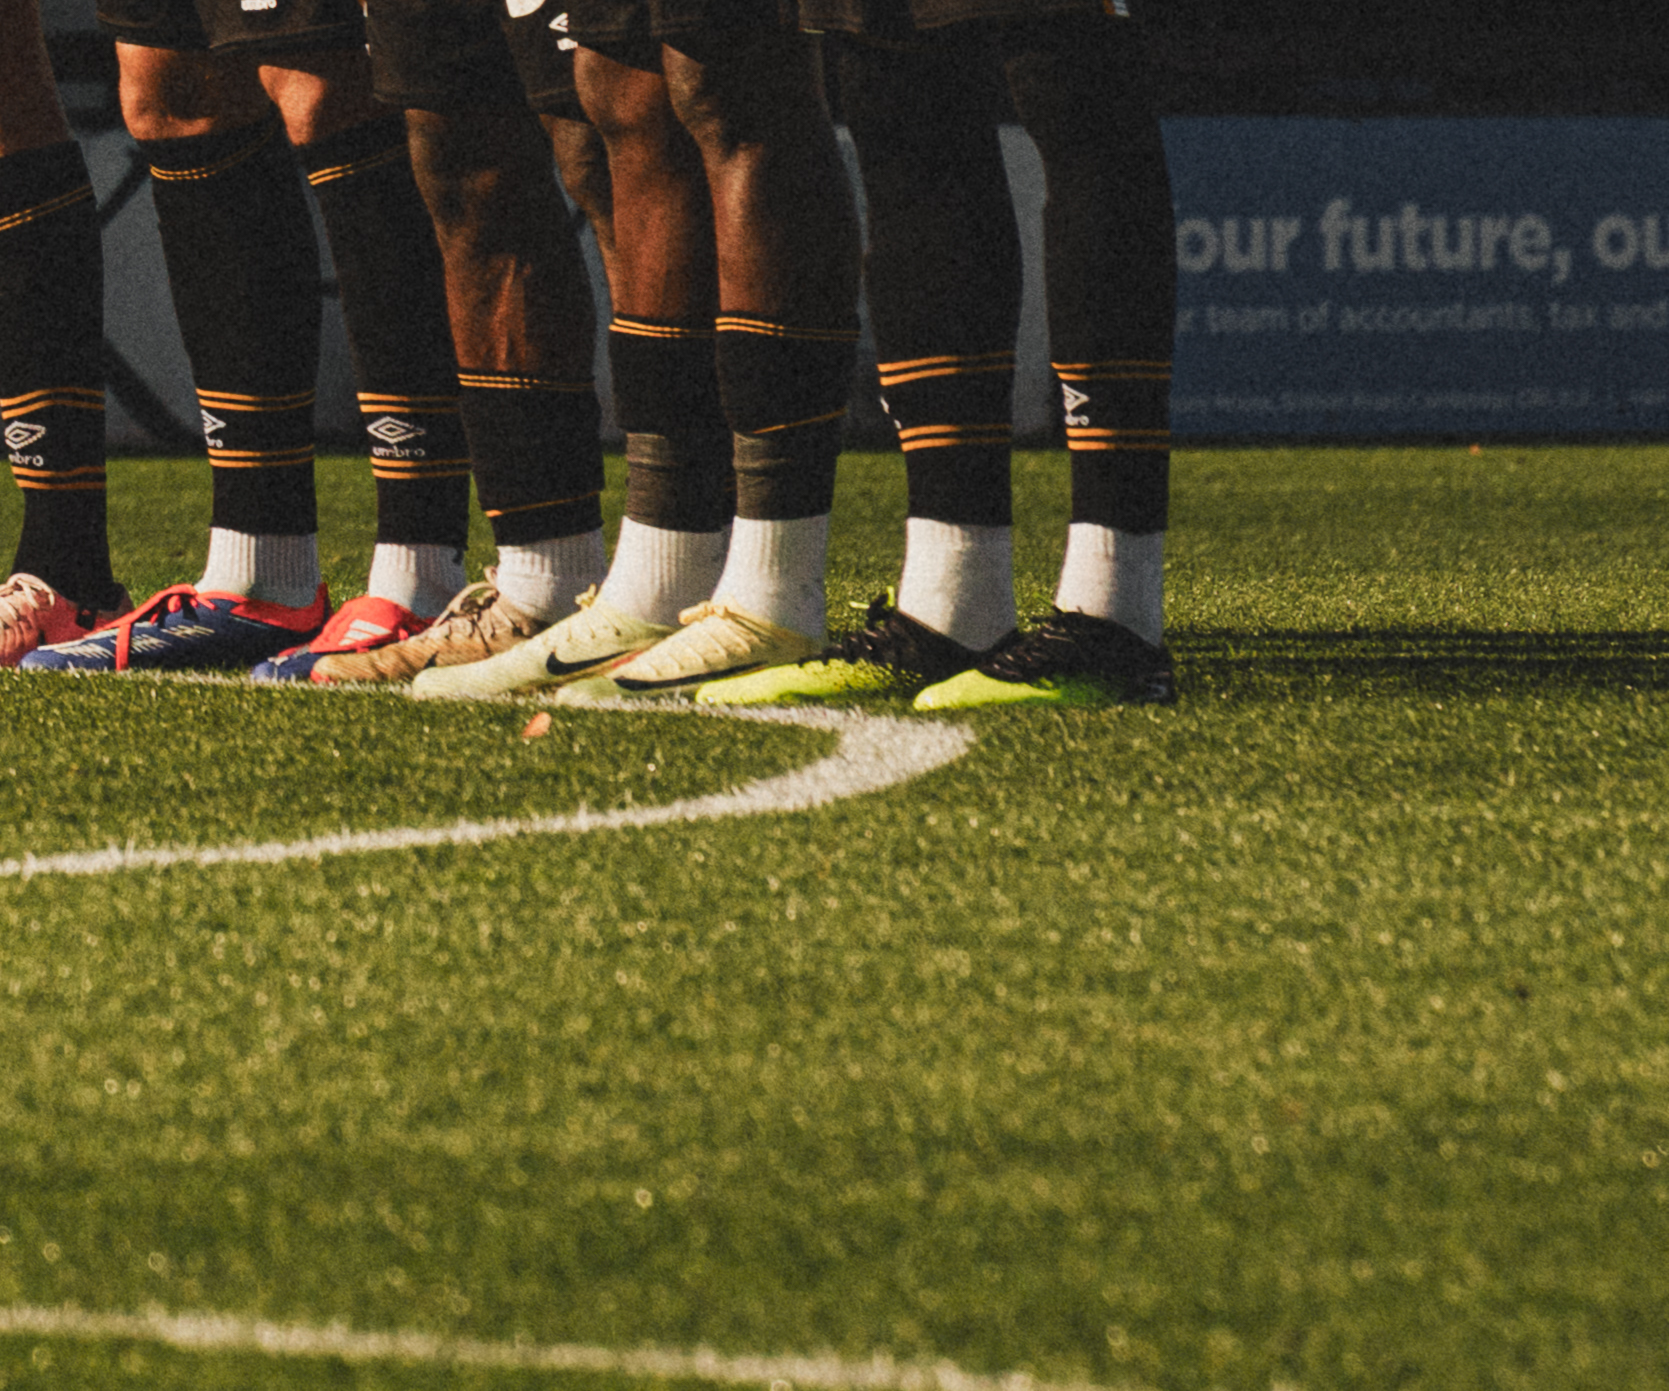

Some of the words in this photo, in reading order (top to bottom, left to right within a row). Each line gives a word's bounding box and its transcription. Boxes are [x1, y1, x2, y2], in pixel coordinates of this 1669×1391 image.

[1173, 203, 1301, 272] our
[1320, 197, 1574, 284] future,
[371, 443, 427, 459] umbro
